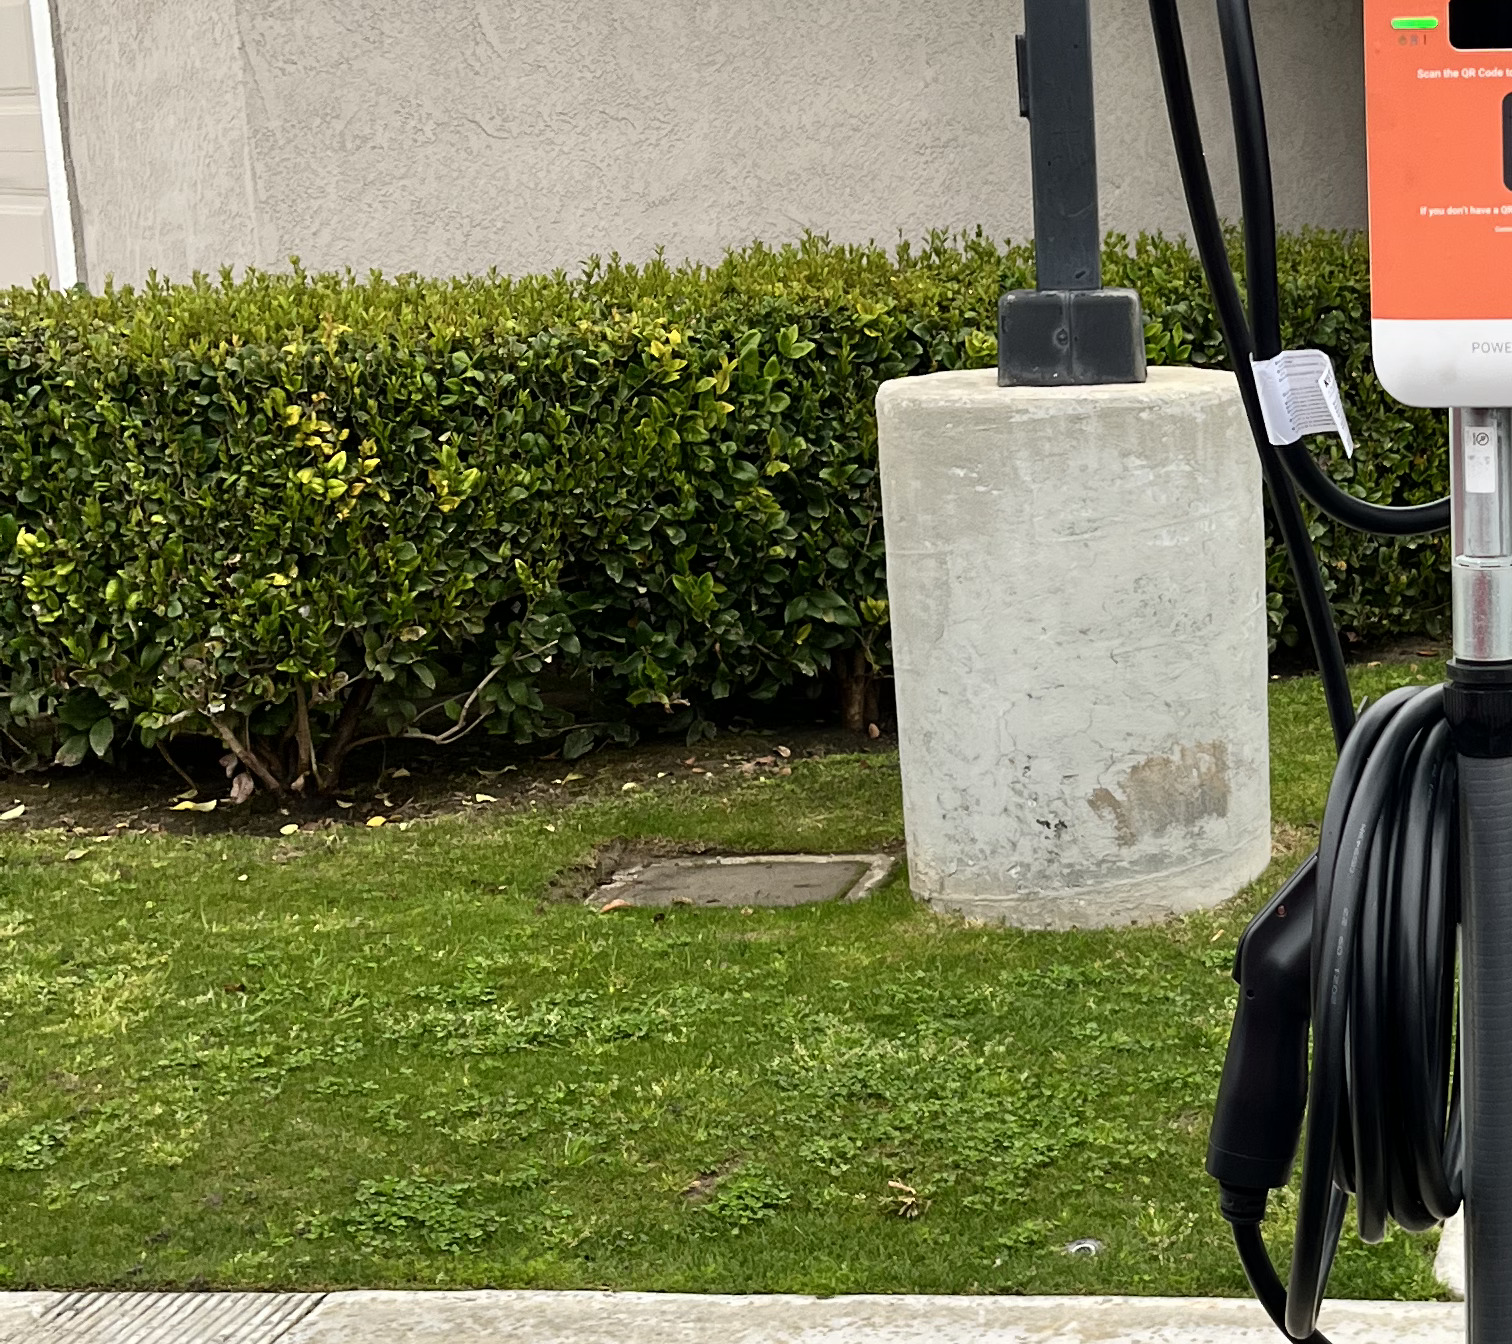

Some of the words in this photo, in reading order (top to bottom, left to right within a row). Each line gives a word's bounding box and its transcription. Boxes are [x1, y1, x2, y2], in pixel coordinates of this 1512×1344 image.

[1417, 69, 1441, 78] Scan
[1443, 68, 1459, 78] the
[1461, 67, 1476, 78] QR
[1478, 67, 1503, 77] Code
[1429, 208, 1445, 218] you
[1446, 206, 1468, 215] don't
[1469, 205, 1491, 215] have
